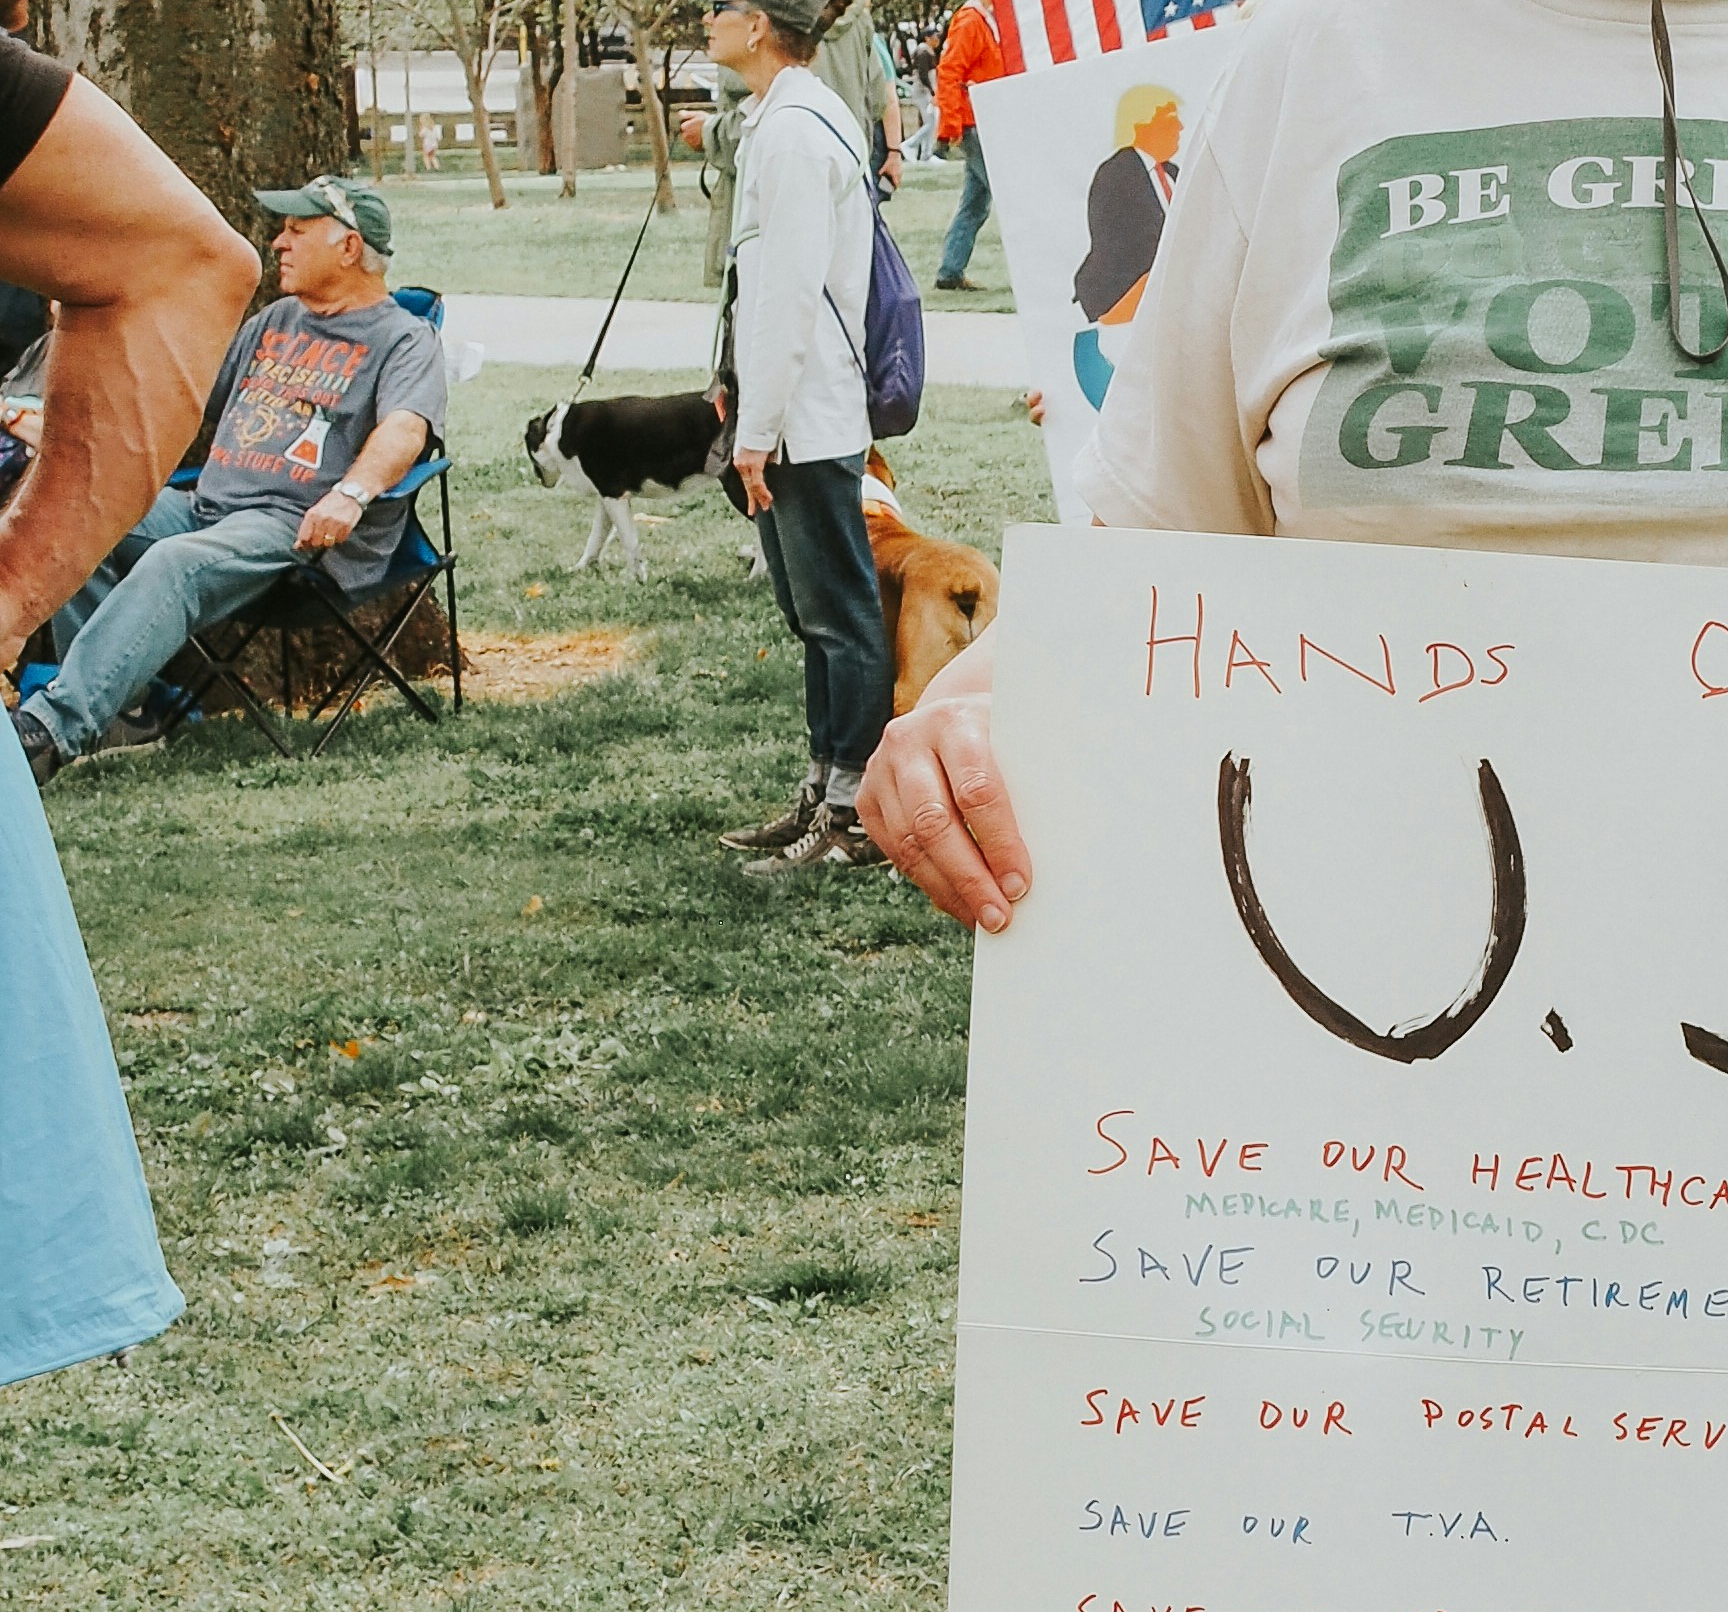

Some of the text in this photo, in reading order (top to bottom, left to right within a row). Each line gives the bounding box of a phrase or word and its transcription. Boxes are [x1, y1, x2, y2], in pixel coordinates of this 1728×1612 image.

[1379, 164, 1511, 239] BE
[1144, 582, 1516, 705] HANDS
[1087, 1109, 1270, 1178] SAVE
[1321, 1139, 1425, 1192] OUR
[1185, 1191, 1666, 1256] MEDICARE, MEDICAID, CDC
[1078, 1229, 1255, 1287] SAVE
[1316, 1256, 1426, 1297] OUR
[1194, 1305, 1526, 1362] SOCIAL SECURITY
[1079, 1388, 1206, 1436] SAVE
[1258, 1400, 1353, 1436] OUR
[1420, 1397, 1580, 1440] POSTAL
[1078, 1499, 1509, 1545] SAVE OUR T.V.A.
